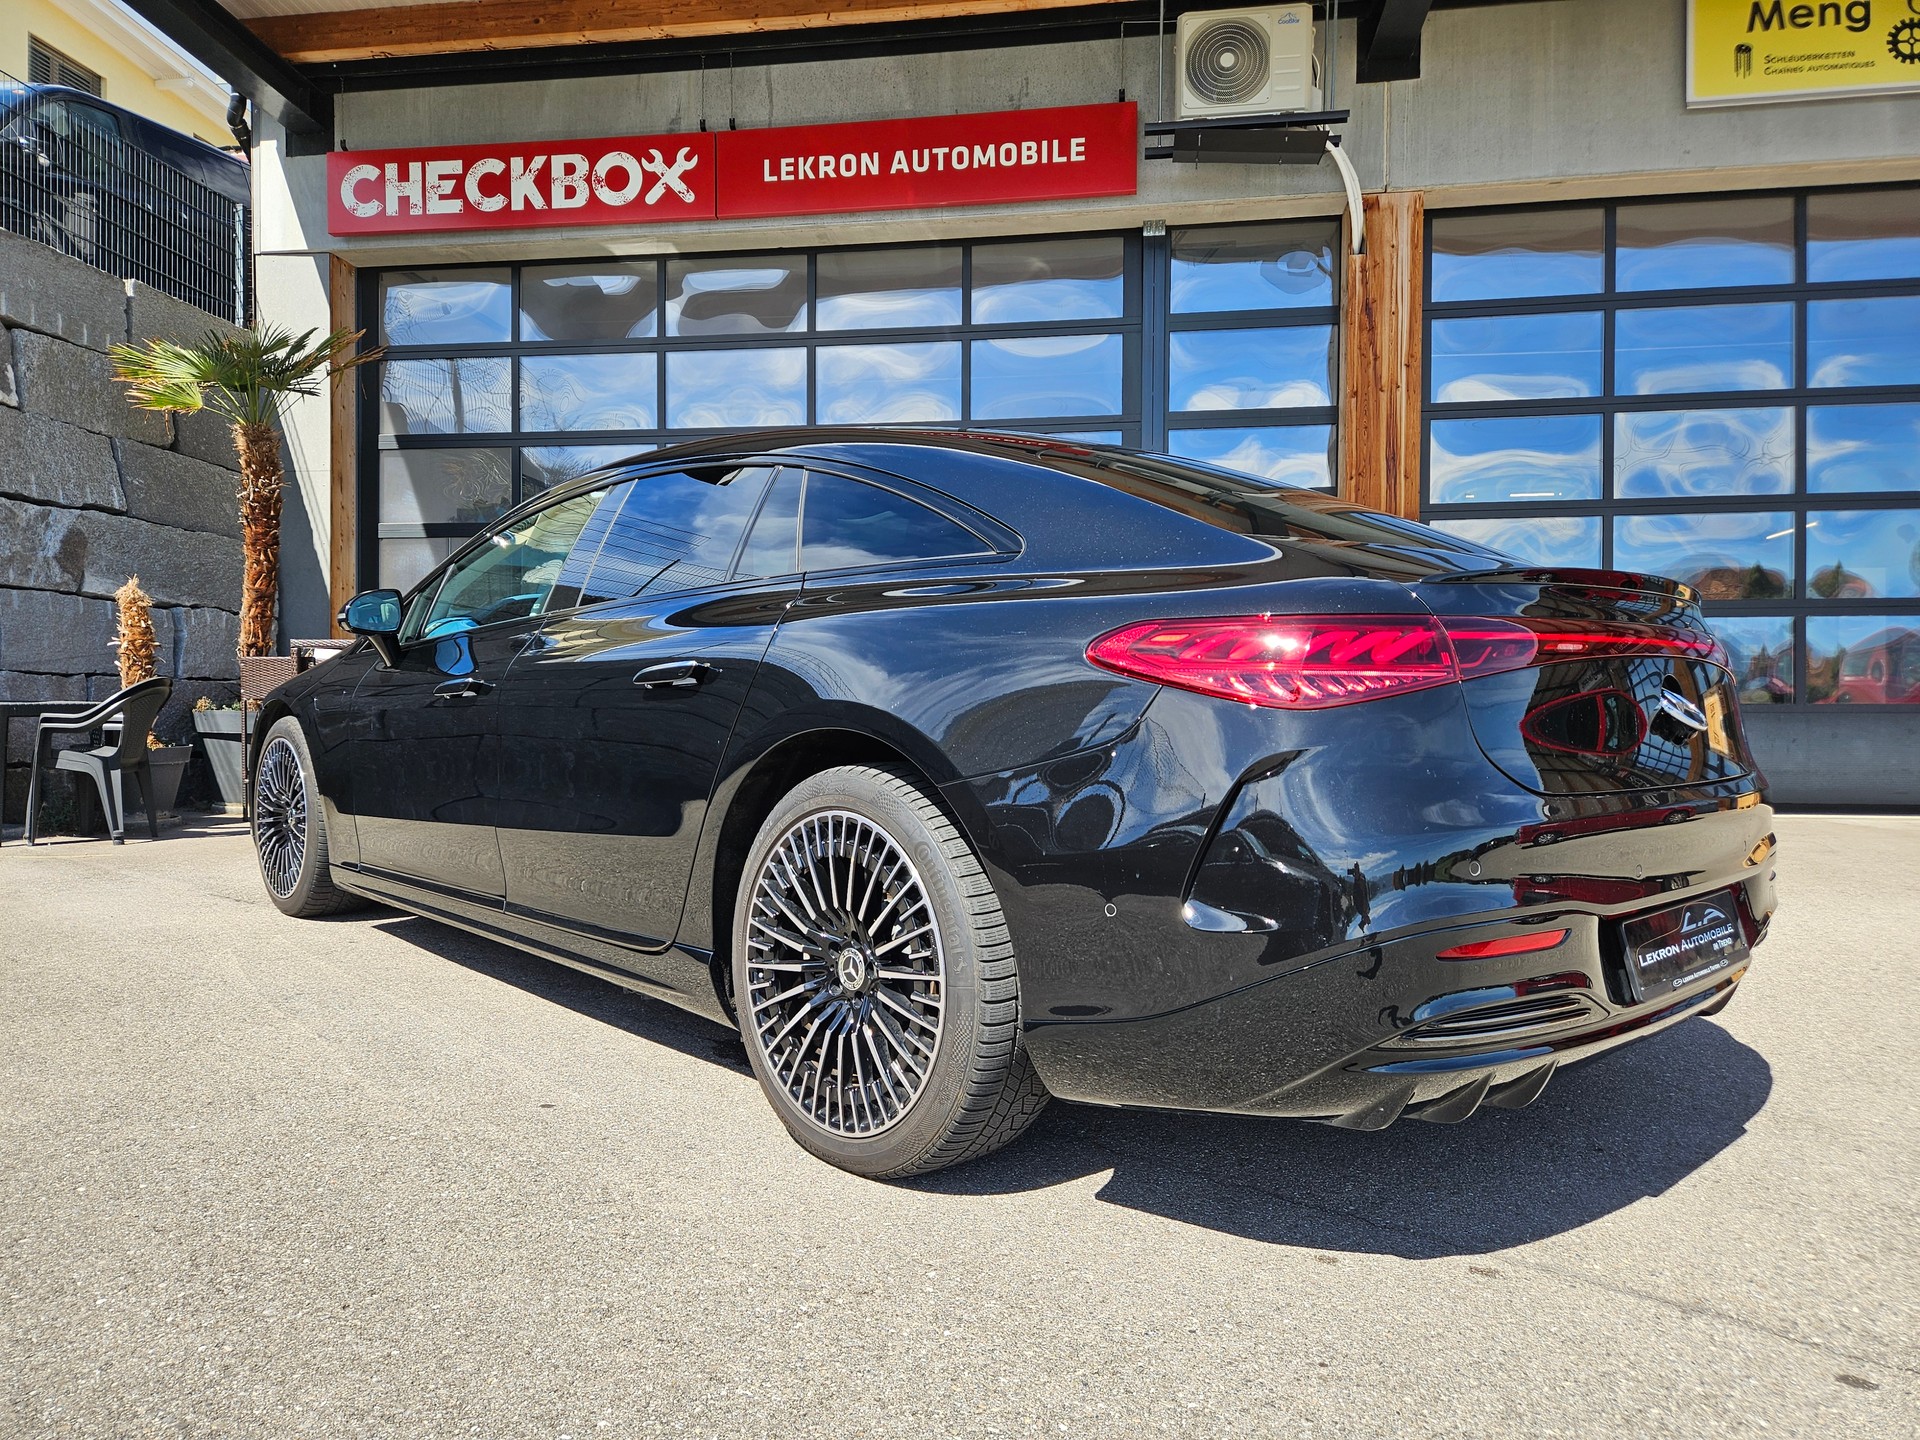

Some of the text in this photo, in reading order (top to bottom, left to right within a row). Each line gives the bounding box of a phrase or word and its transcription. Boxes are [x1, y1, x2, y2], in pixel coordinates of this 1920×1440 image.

[1746, 0, 1871, 33] Meng
[763, 137, 1086, 182] LEKRON AUTOMOBILE
[1638, 922, 1735, 968] LEKRON AUTOMOBILE
